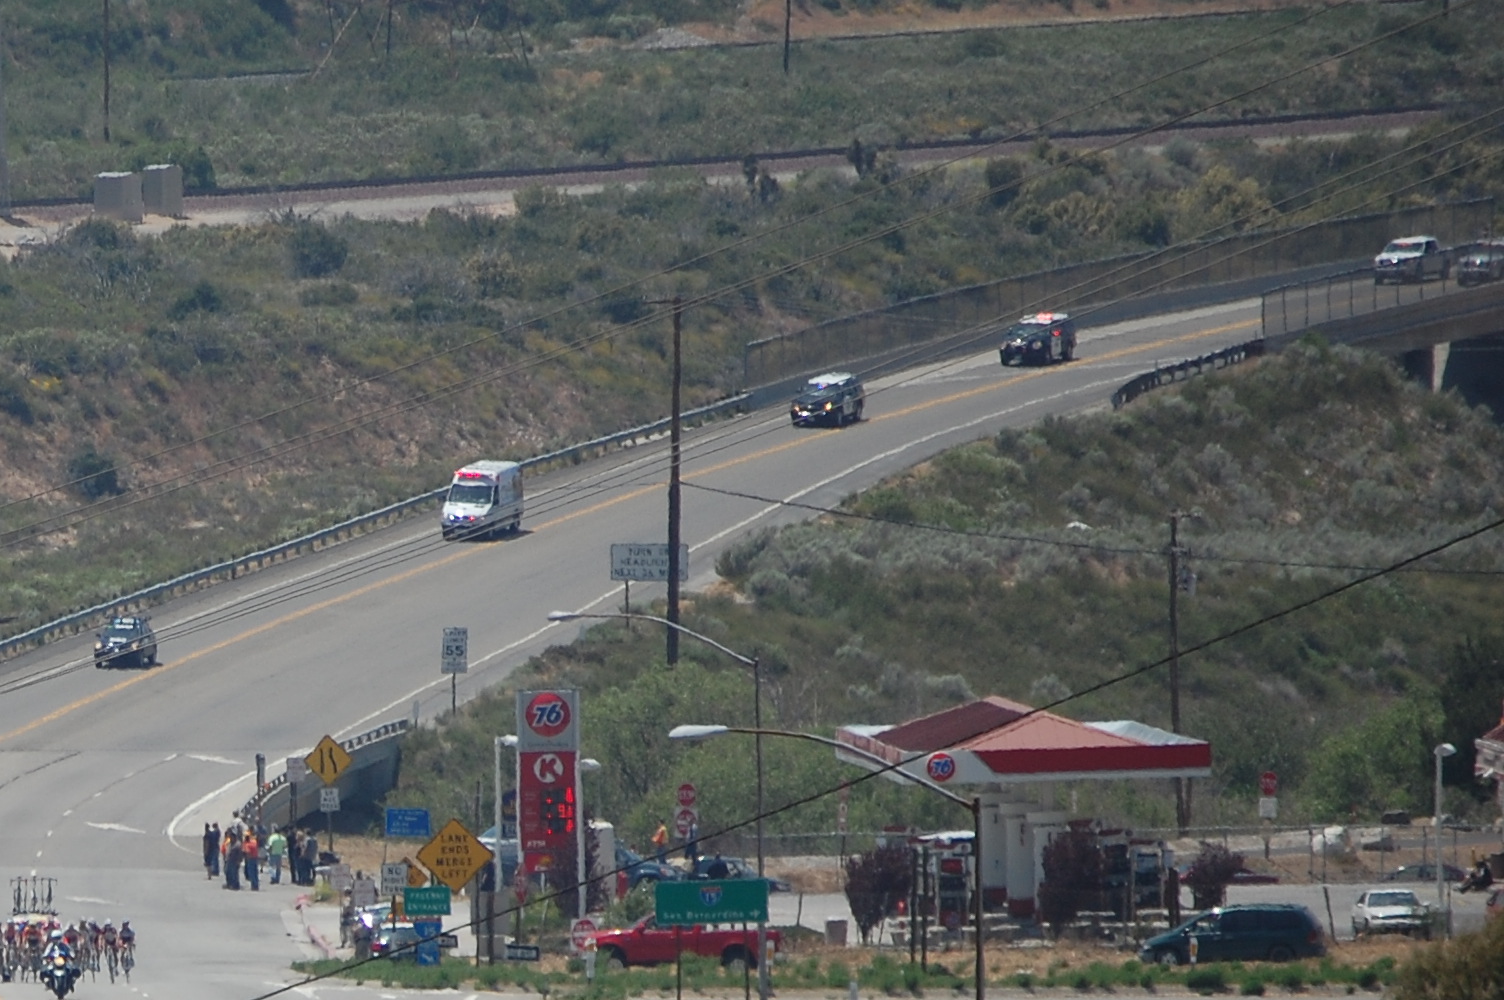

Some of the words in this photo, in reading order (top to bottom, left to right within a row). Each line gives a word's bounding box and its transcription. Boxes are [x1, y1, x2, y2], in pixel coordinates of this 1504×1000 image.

[446, 645, 464, 656] 55
[532, 702, 564, 727] 76
[539, 758, 557, 778] K
[930, 758, 952, 776] 76
[441, 834, 468, 843] LANE
[441, 845, 470, 854] ENDS
[436, 857, 473, 866] MERGE
[441, 869, 468, 878] LEFT
